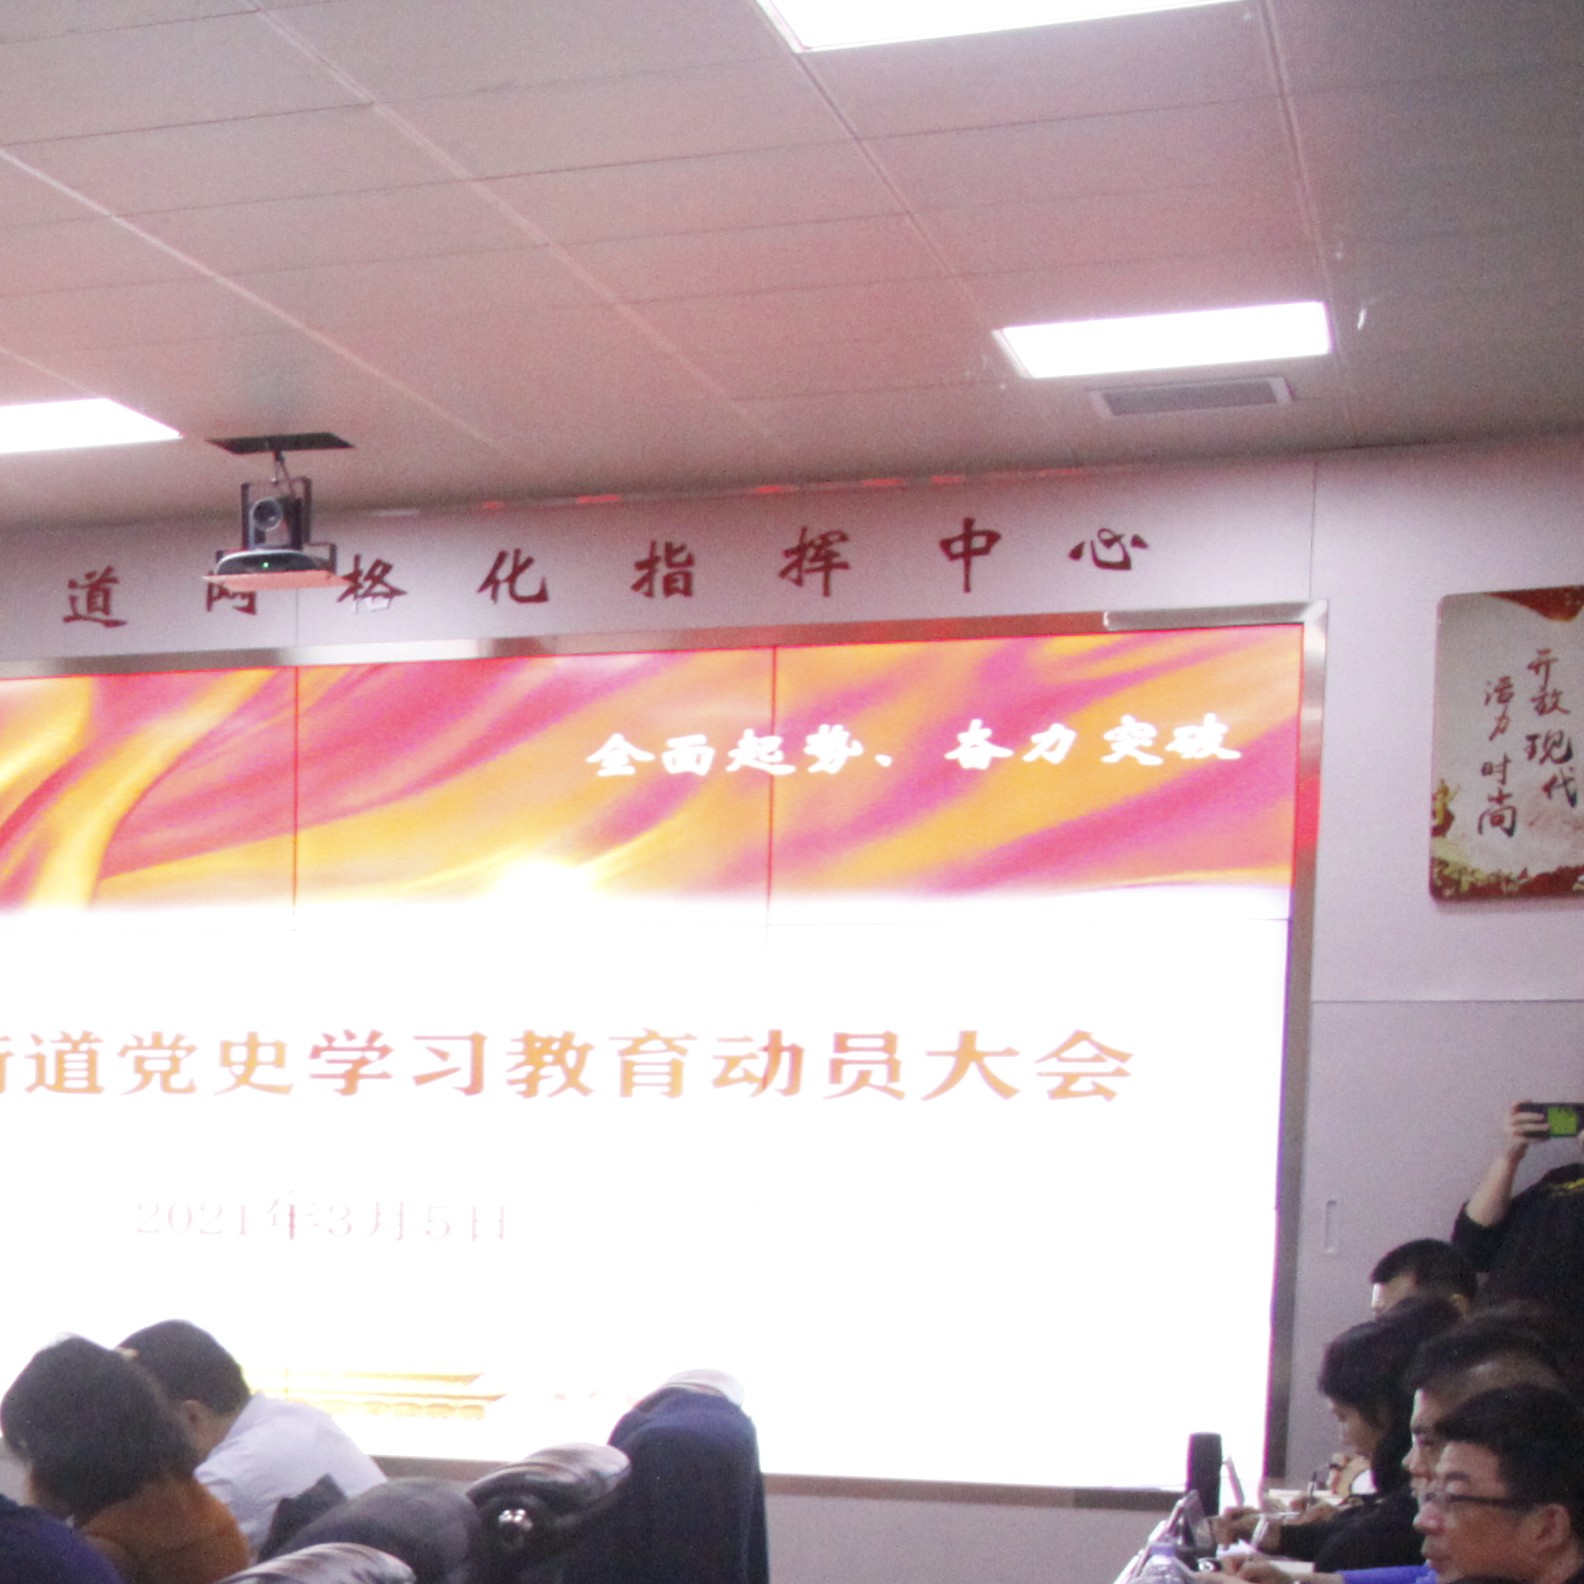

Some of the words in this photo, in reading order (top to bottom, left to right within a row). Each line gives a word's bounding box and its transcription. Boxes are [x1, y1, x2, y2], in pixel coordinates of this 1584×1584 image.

[1477, 675, 1517, 837] 活力时尚
[135, 1197, 508, 1241] 2021年3月5日
